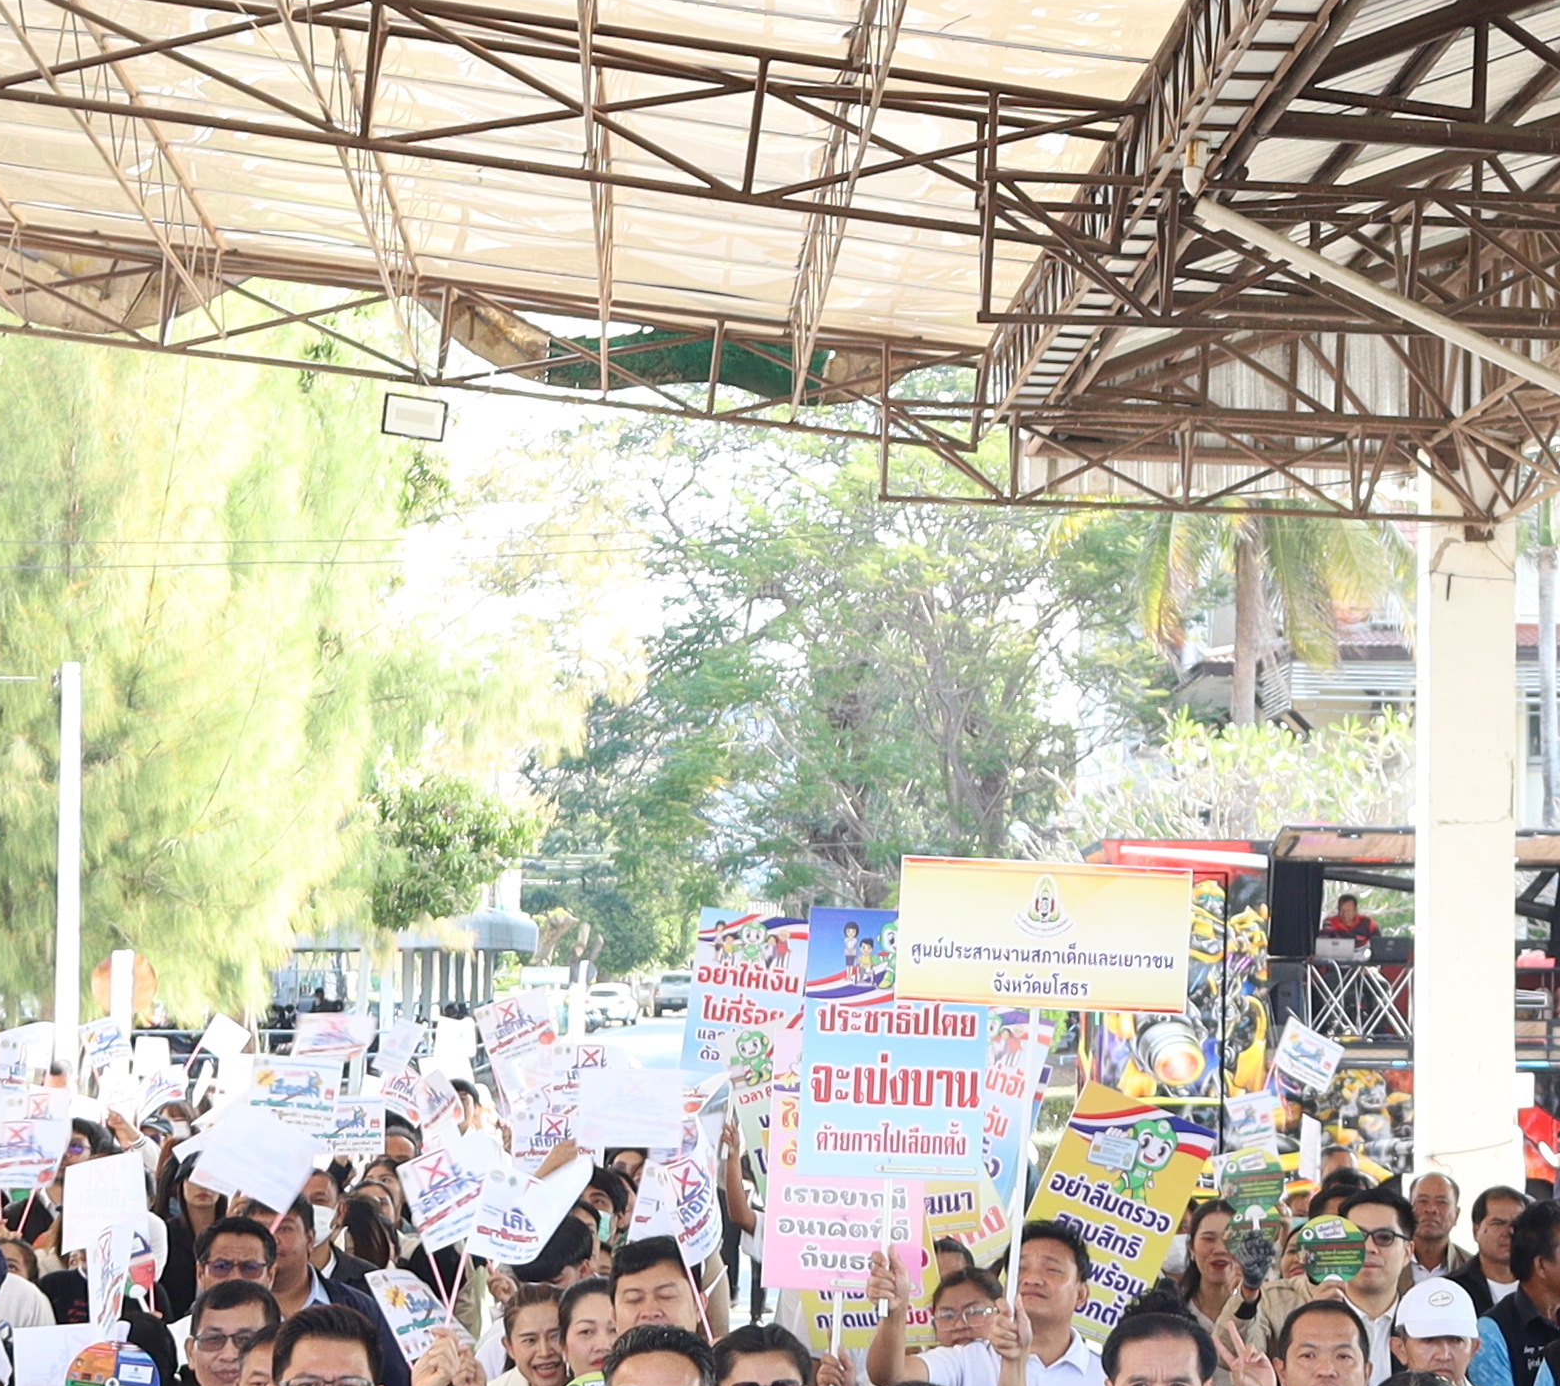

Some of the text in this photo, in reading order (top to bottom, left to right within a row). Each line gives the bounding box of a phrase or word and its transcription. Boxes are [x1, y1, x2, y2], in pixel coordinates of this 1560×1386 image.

[911, 940, 1175, 971] ศูนย์ประสานงานสภาเด็กและเยาวชน
[697, 962, 800, 994] อย่าให้เงิน
[993, 974, 1089, 998] จังหวัดยโสธร
[818, 1003, 976, 1038] ประชาธิปไตย
[811, 1056, 980, 1108] จะเบ่งบาน
[816, 1121, 967, 1158] ด้วยการไปเลือกตั้ง
[1050, 1172, 1172, 1234] อย่าลืมตรวจ
